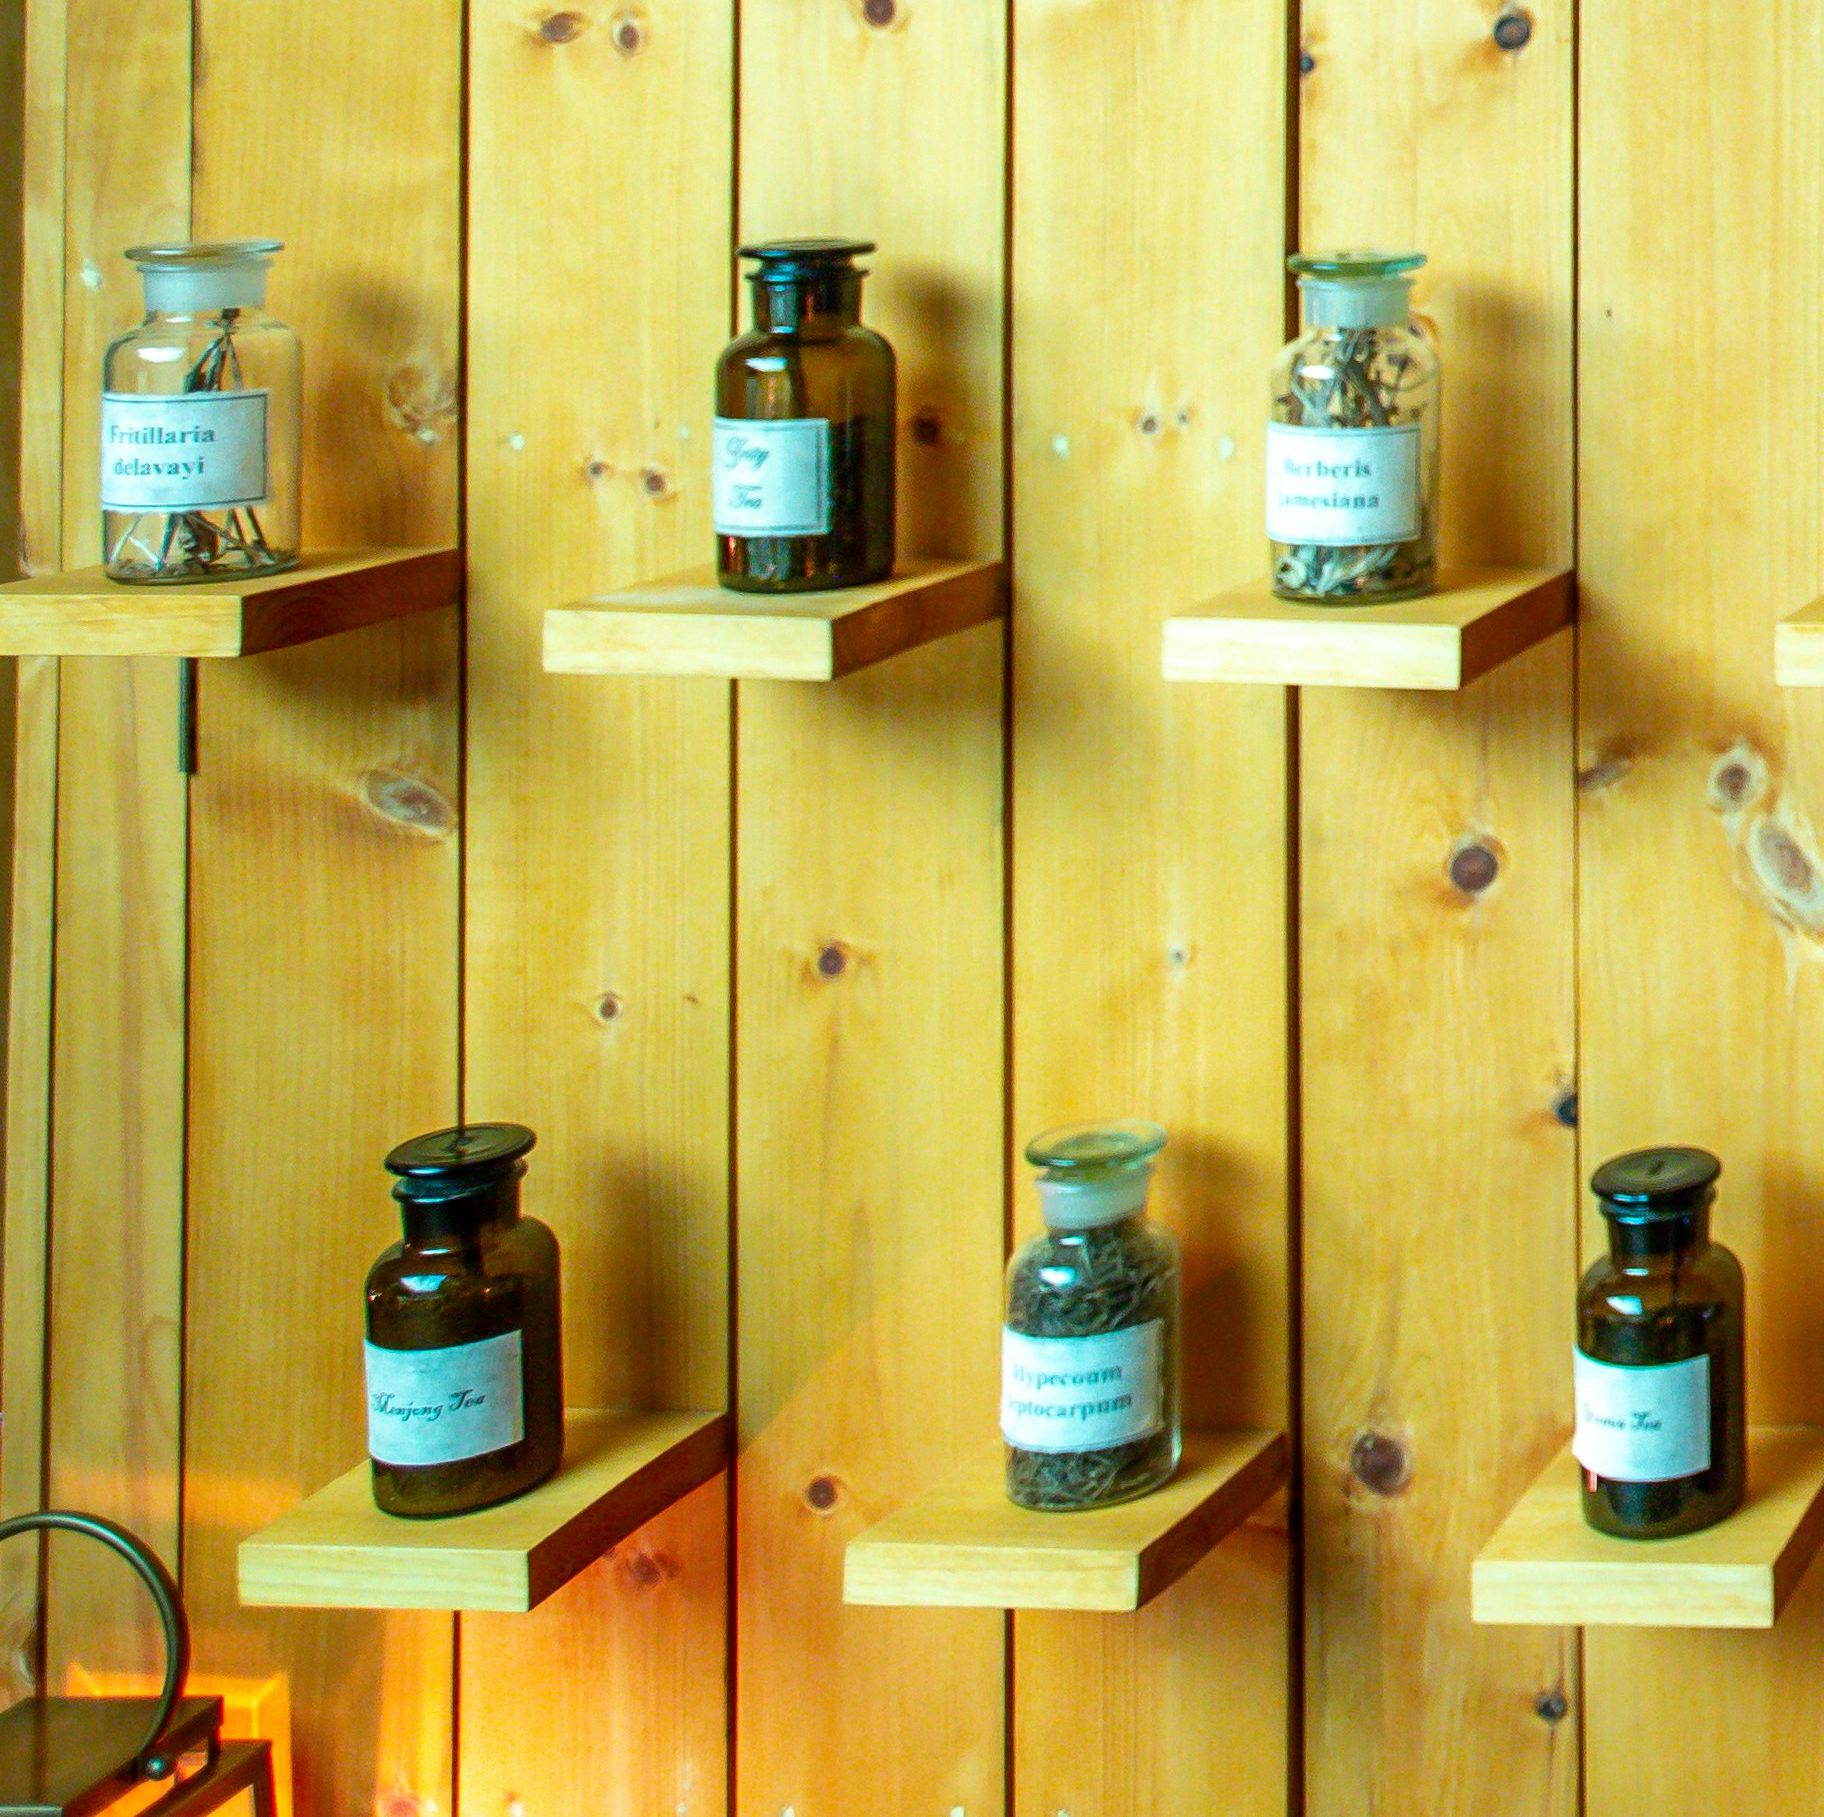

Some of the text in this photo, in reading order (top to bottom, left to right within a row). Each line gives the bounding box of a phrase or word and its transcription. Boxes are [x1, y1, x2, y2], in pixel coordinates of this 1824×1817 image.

[109, 424, 217, 445] Fritillaria
[113, 456, 205, 480] delavayi
[448, 1389, 486, 1412] Tea
